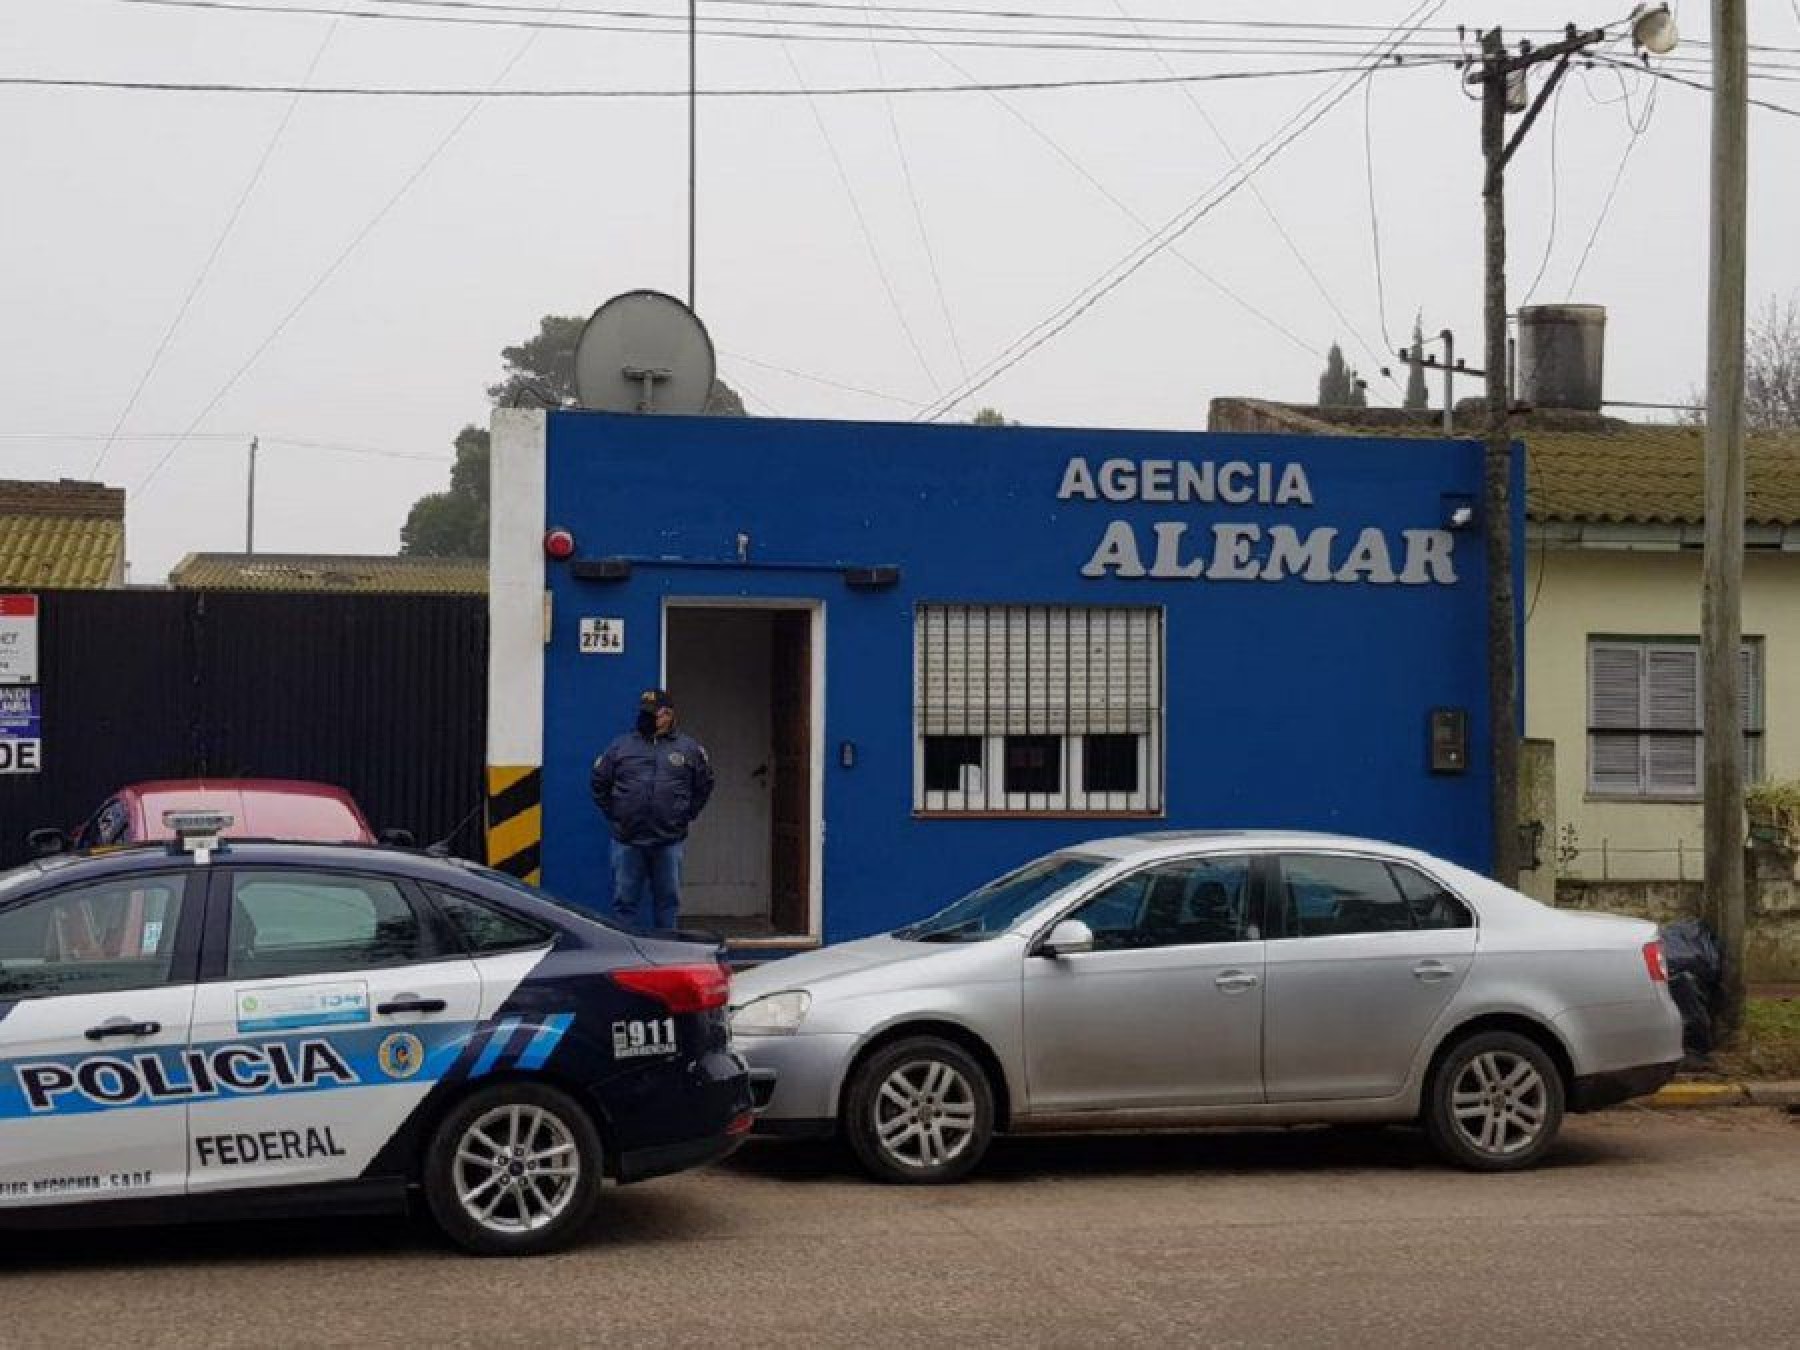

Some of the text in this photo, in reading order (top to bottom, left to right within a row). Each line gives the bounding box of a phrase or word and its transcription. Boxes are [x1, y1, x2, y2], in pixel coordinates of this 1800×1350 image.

[1057, 457, 1313, 505] AGENCIA
[1081, 520, 1458, 584] ALEMAR
[629, 1018, 675, 1047] 911
[16, 1040, 358, 1111] POLICIA
[195, 1127, 346, 1166] FEDERAL
